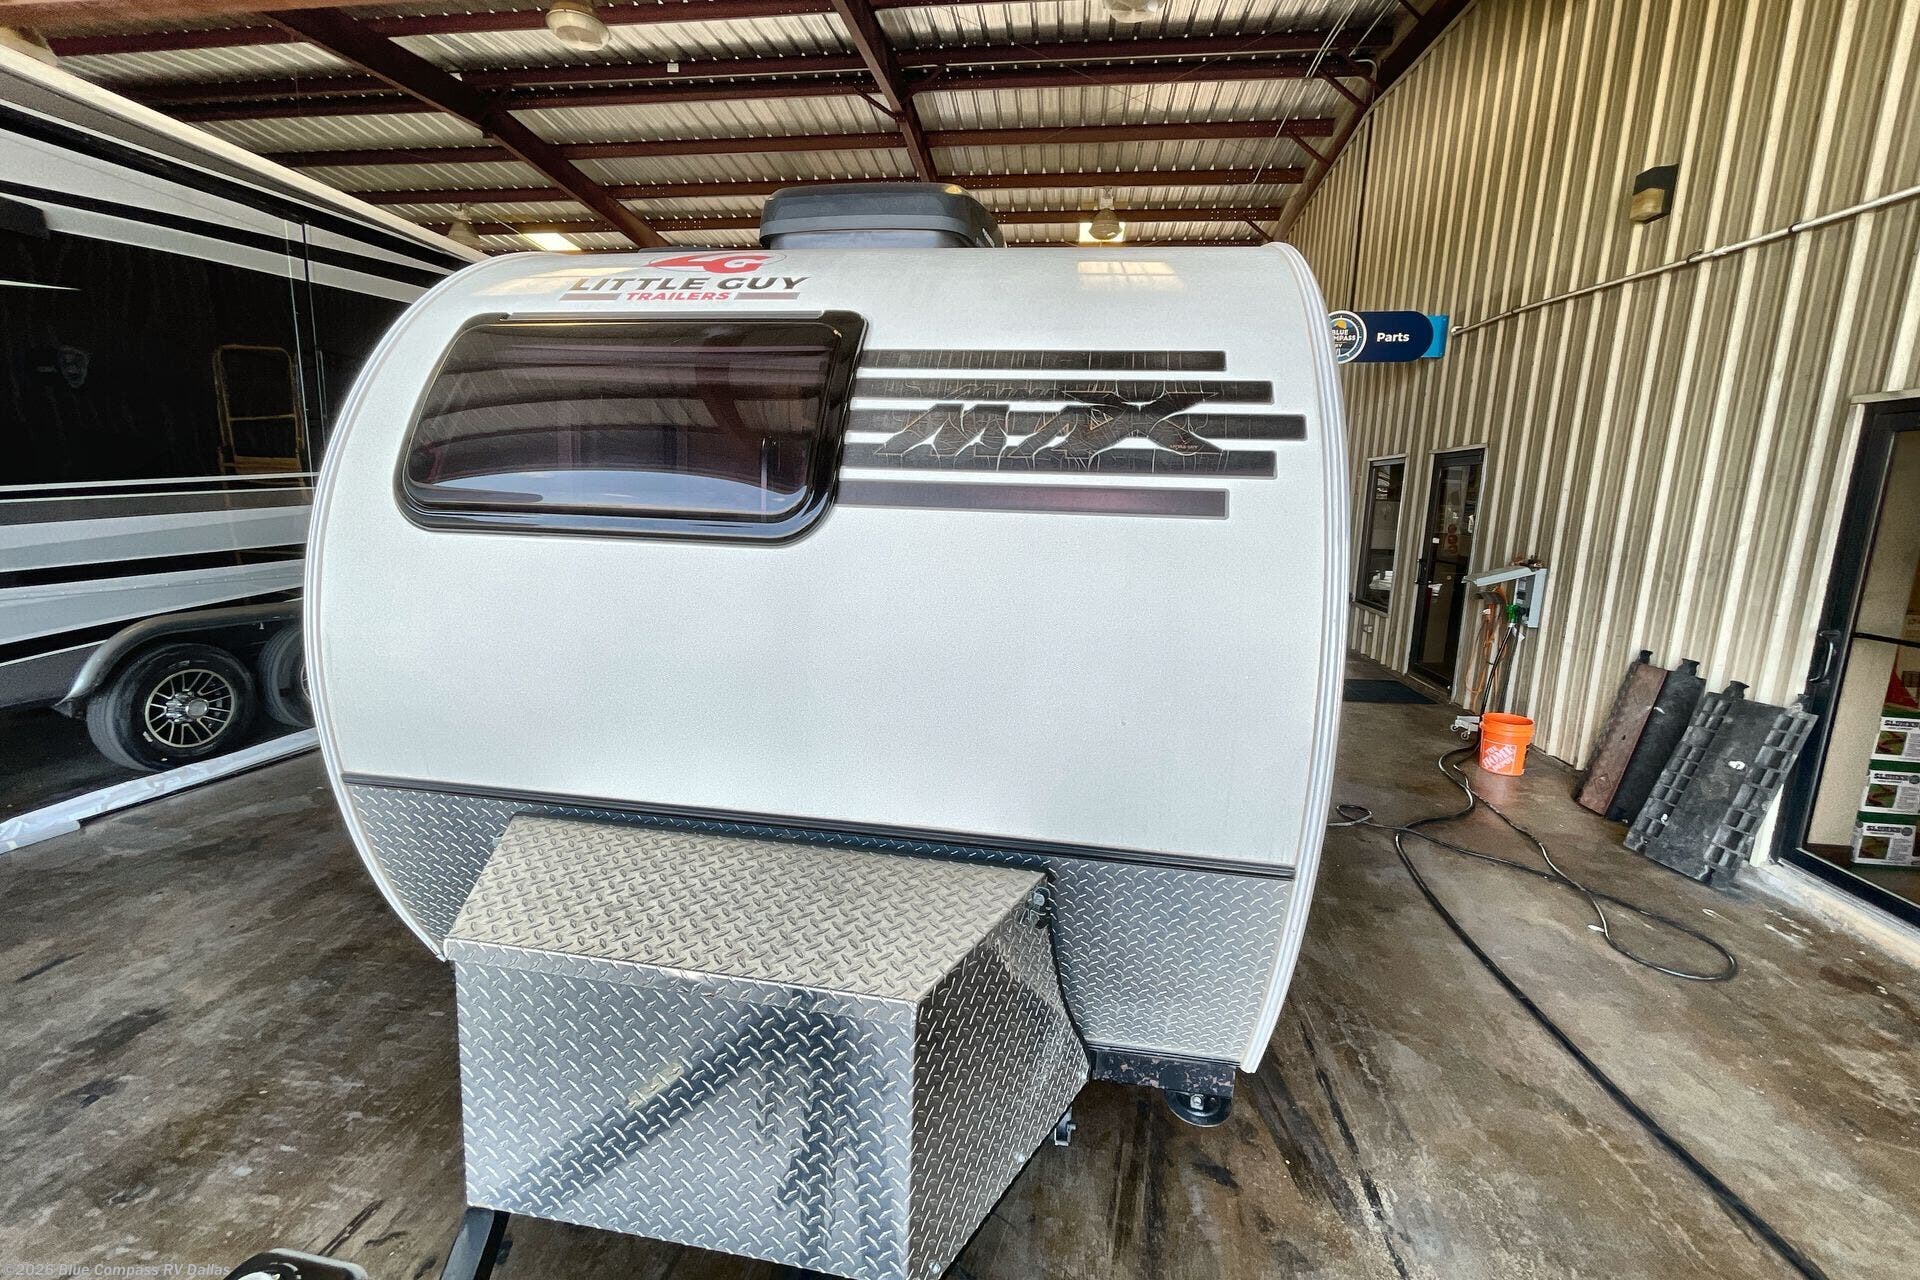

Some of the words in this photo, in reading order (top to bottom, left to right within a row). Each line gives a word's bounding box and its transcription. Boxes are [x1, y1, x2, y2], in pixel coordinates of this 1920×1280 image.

[569, 276, 711, 291] LITTLE
[717, 276, 812, 291] GUY
[626, 291, 731, 301] TRAILERS
[1376, 332, 1410, 343] Parts
[875, 387, 1223, 456] MAX
